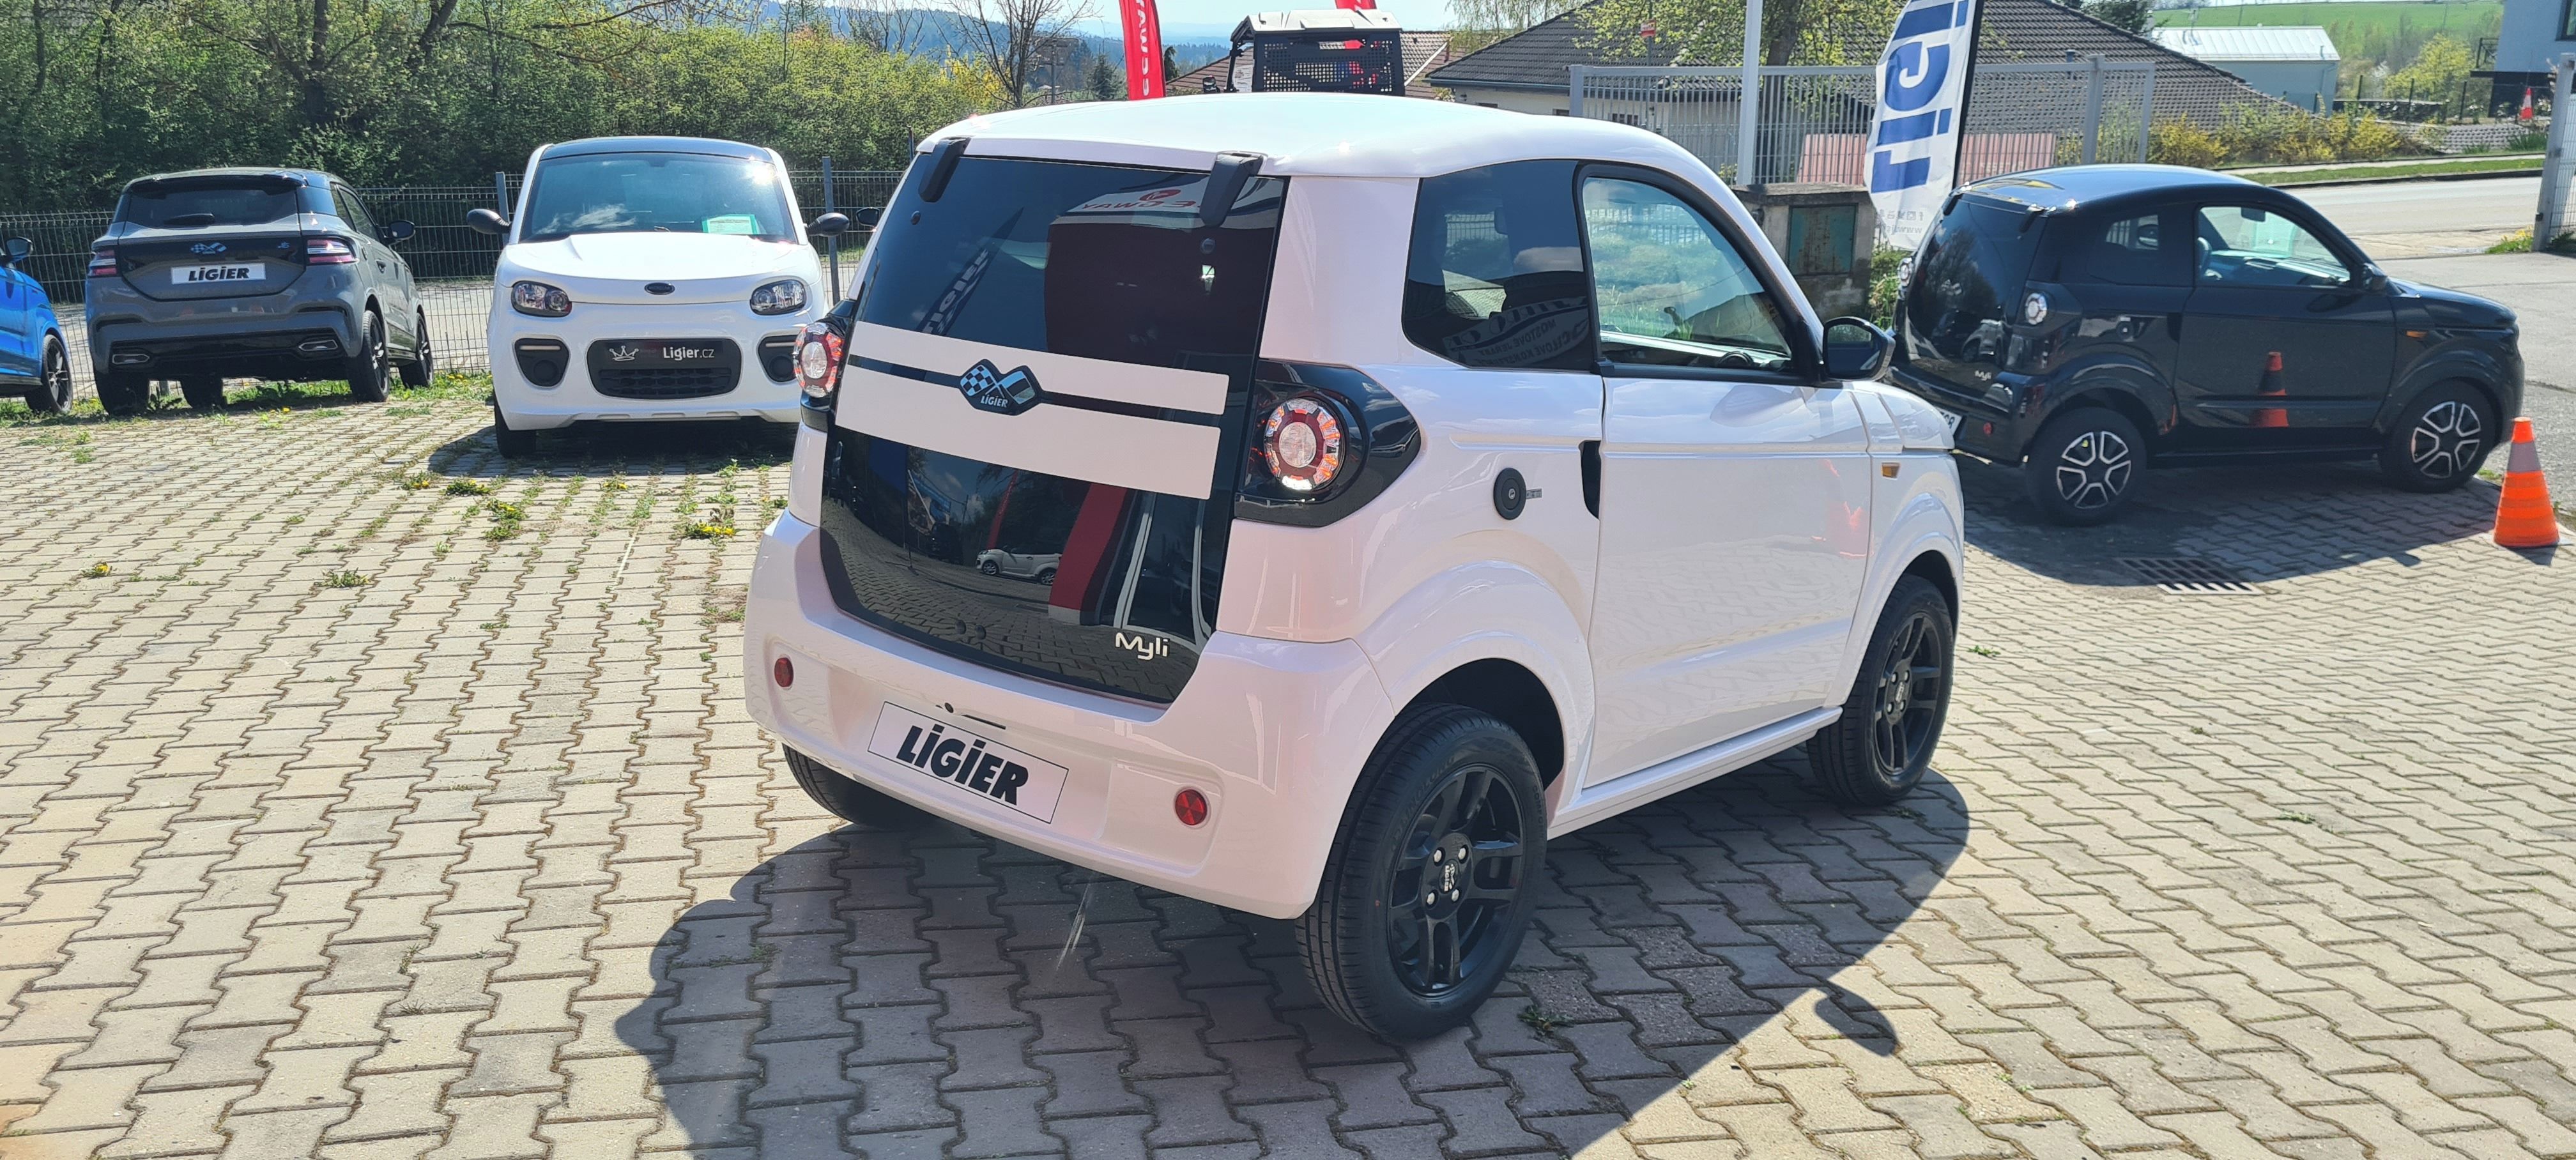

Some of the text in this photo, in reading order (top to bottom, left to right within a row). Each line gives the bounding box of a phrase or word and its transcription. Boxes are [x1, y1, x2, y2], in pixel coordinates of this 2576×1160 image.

[663, 347, 715, 360] Ligier.cz
[1975, 370, 1991, 381] Myli
[1116, 632, 1169, 660] Myli
